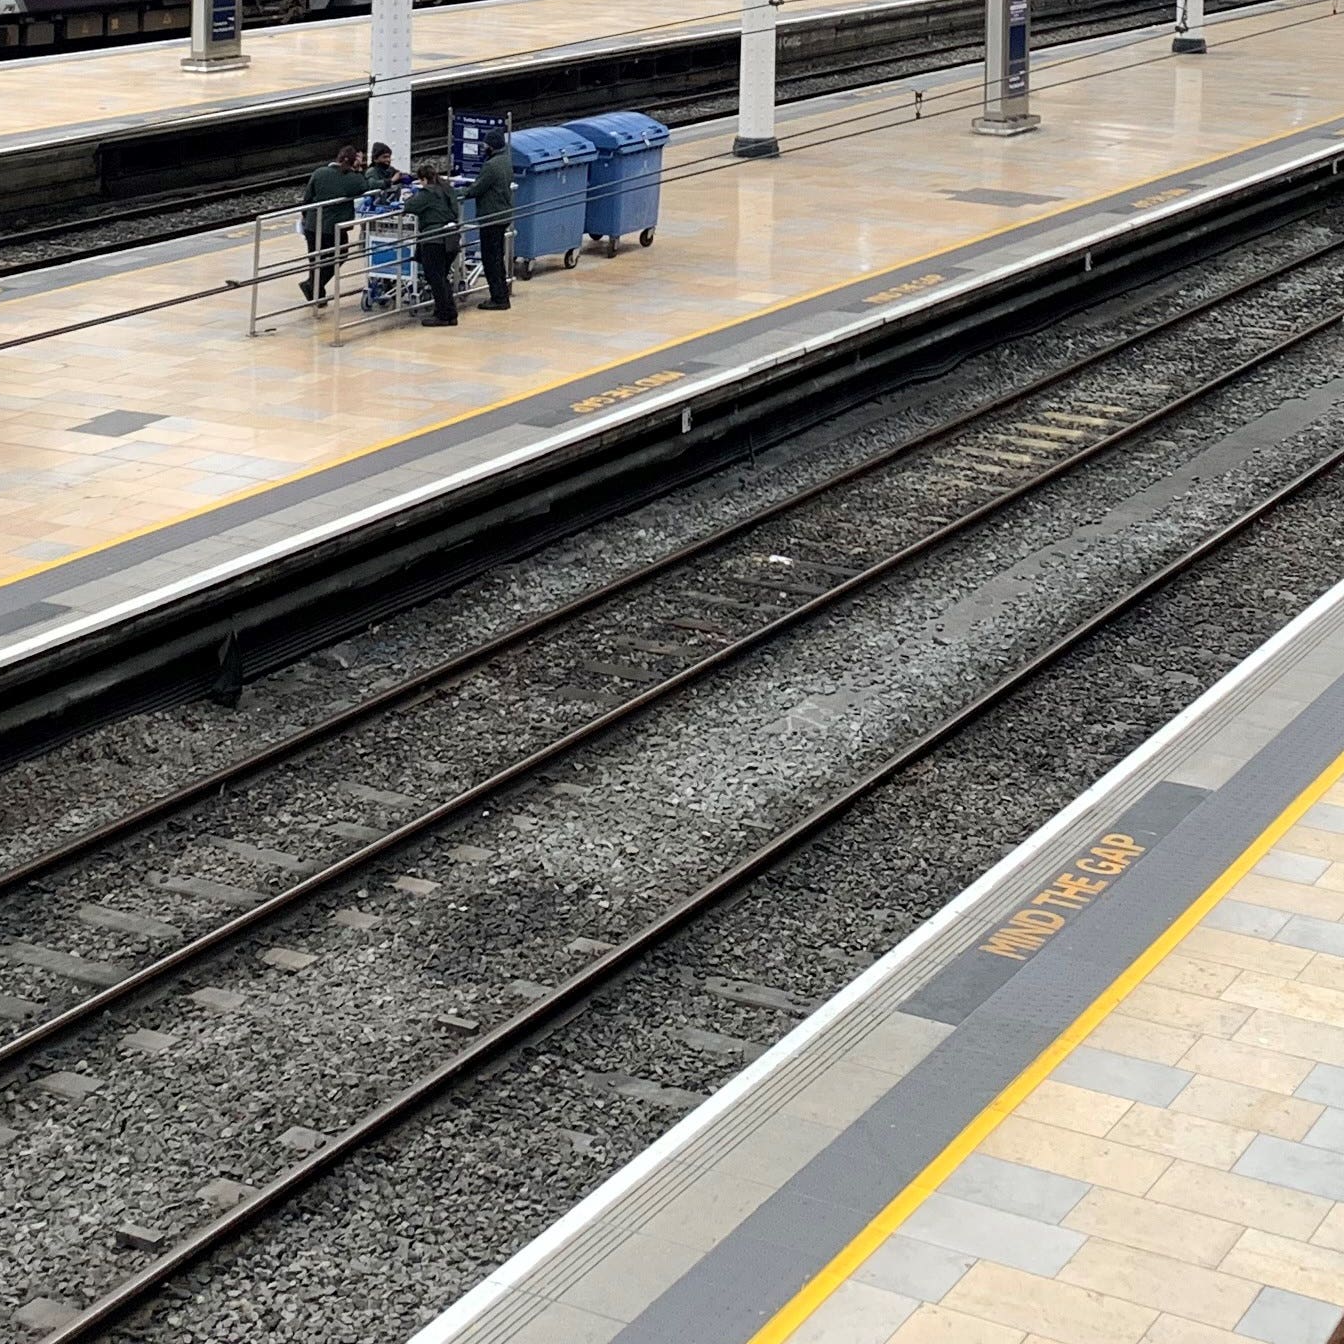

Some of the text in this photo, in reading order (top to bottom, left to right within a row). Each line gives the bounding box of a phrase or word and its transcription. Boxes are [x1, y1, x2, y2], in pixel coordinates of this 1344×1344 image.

[977, 833, 1147, 961] MIND THE GAP
